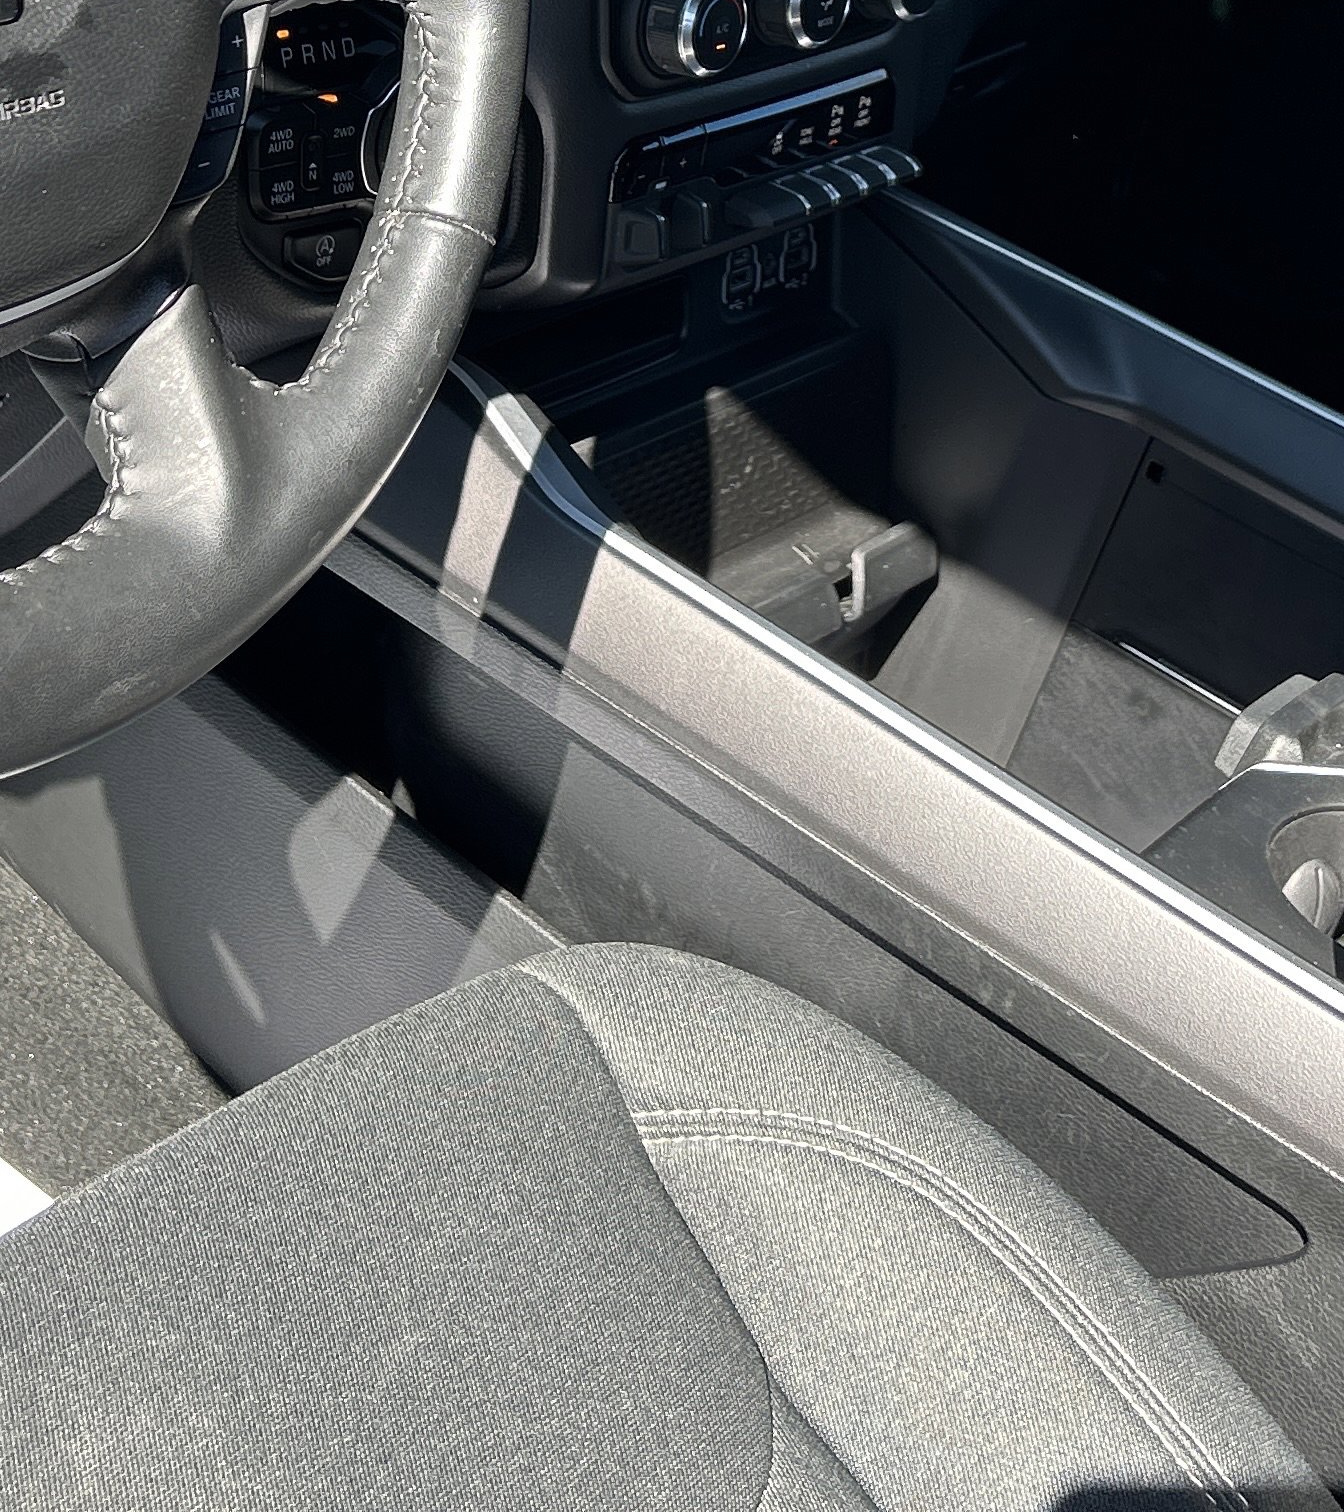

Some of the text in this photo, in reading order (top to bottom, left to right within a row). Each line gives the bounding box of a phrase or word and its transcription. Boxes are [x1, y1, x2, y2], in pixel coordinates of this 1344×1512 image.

[281, 37, 355, 69] P R N D
[208, 86, 240, 106] GEAR
[206, 102, 236, 121] LIMIT
[270, 128, 293, 143] 4WD
[333, 125, 356, 140] 2WD
[268, 139, 295, 155] AUTO
[332, 169, 354, 184] 4WD
[271, 179, 294, 193] 4WD
[333, 179, 355, 194] LOW
[271, 191, 295, 207] HIGH
[316, 252, 333, 267] OFF
